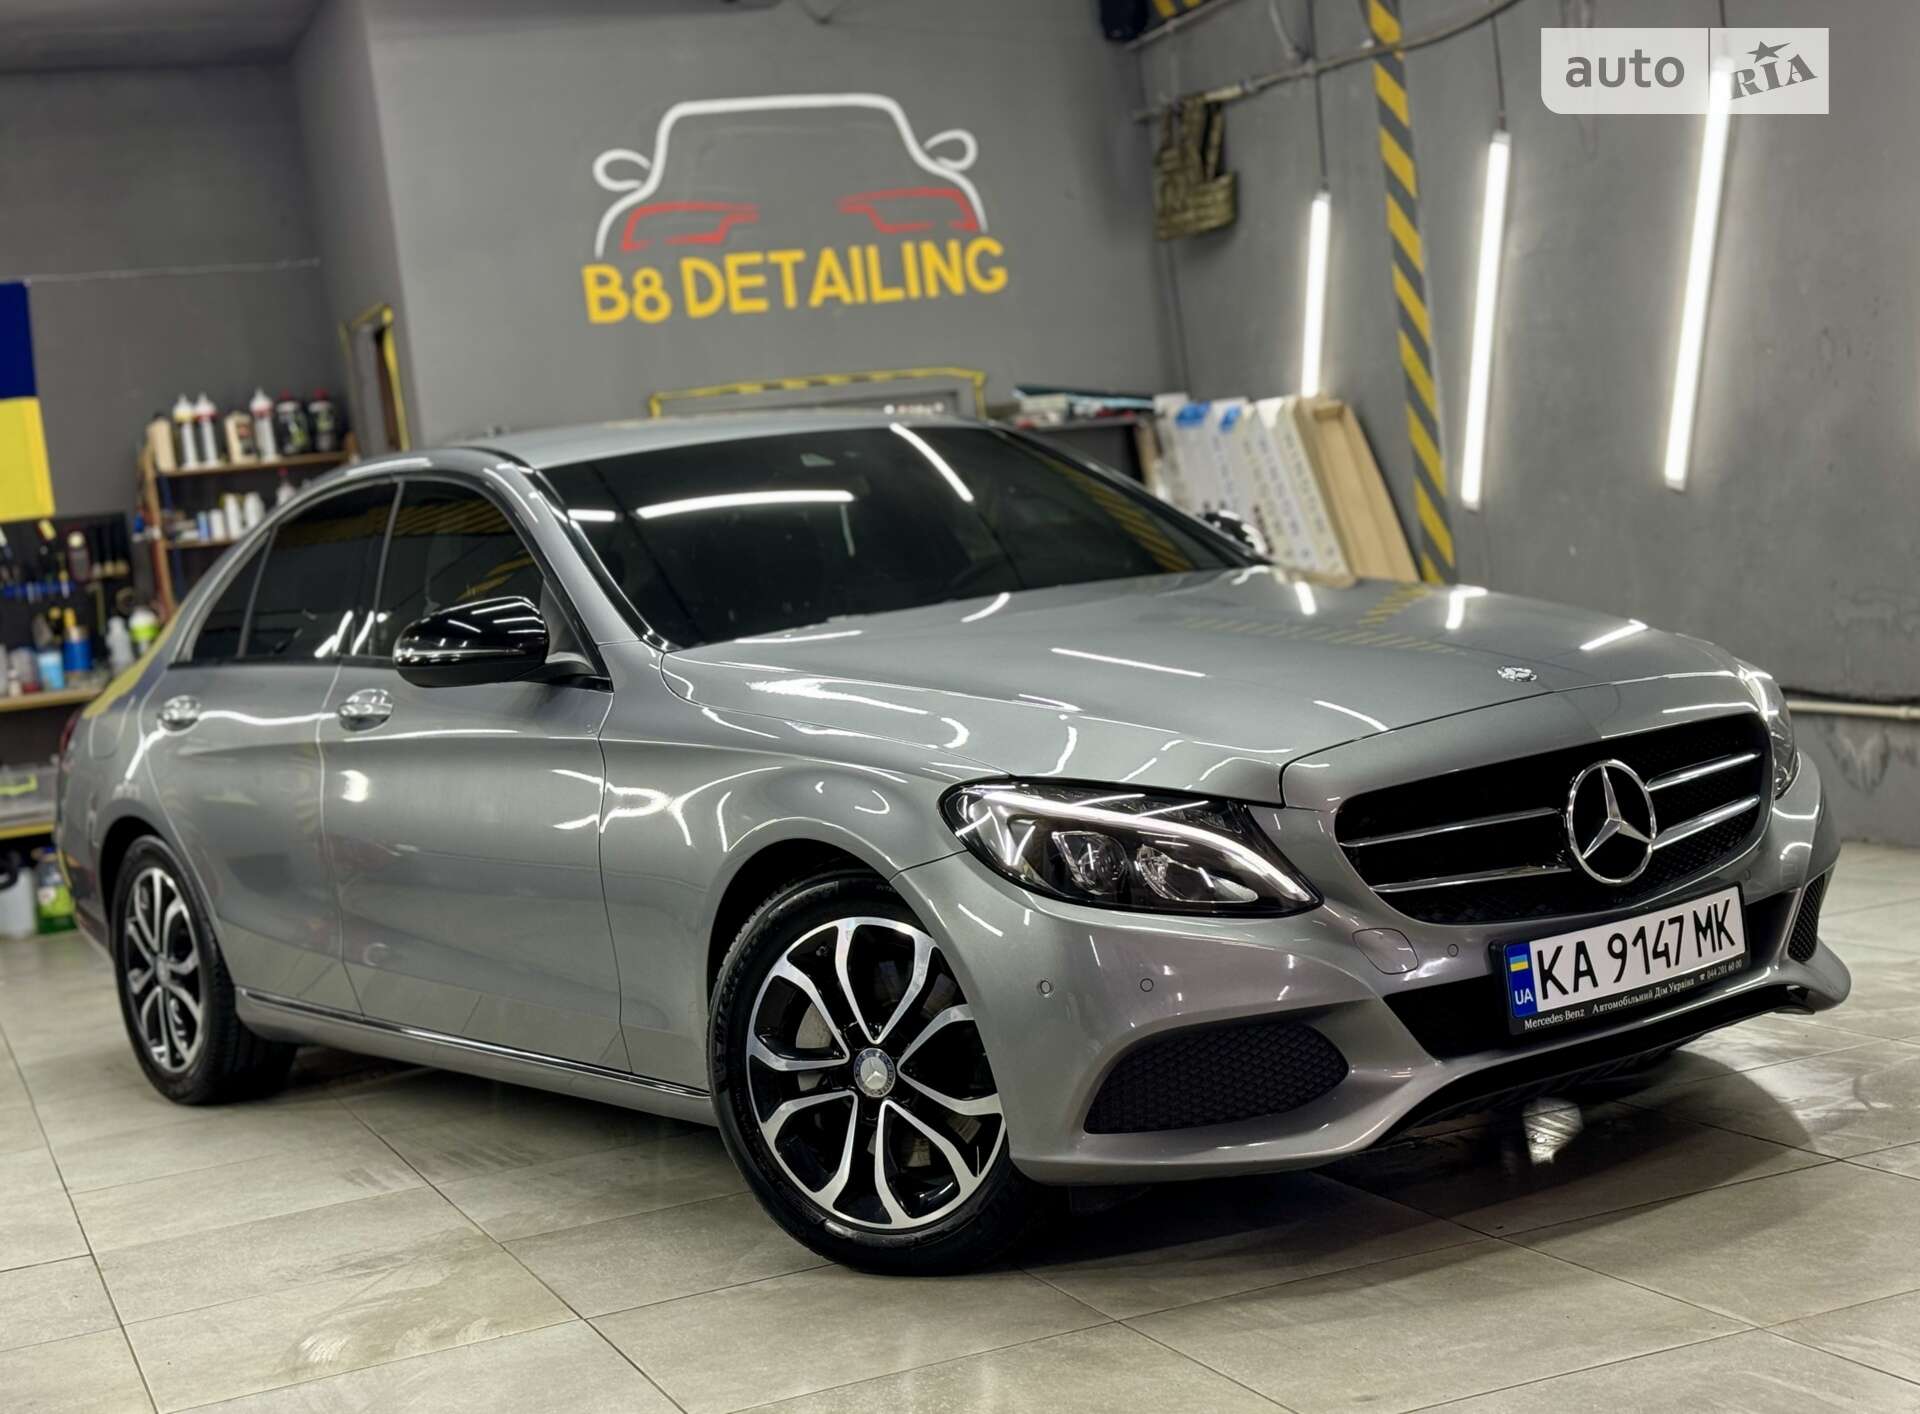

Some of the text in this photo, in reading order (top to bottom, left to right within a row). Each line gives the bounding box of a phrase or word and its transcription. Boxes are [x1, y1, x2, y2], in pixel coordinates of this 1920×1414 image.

[582, 236, 1008, 325] B8 DETAILING
[1537, 898, 1736, 1000] KA 9147 MK
[1514, 987, 1534, 1005] UA
[1655, 987, 1668, 999] Дім
[1668, 978, 1695, 993] Україна
